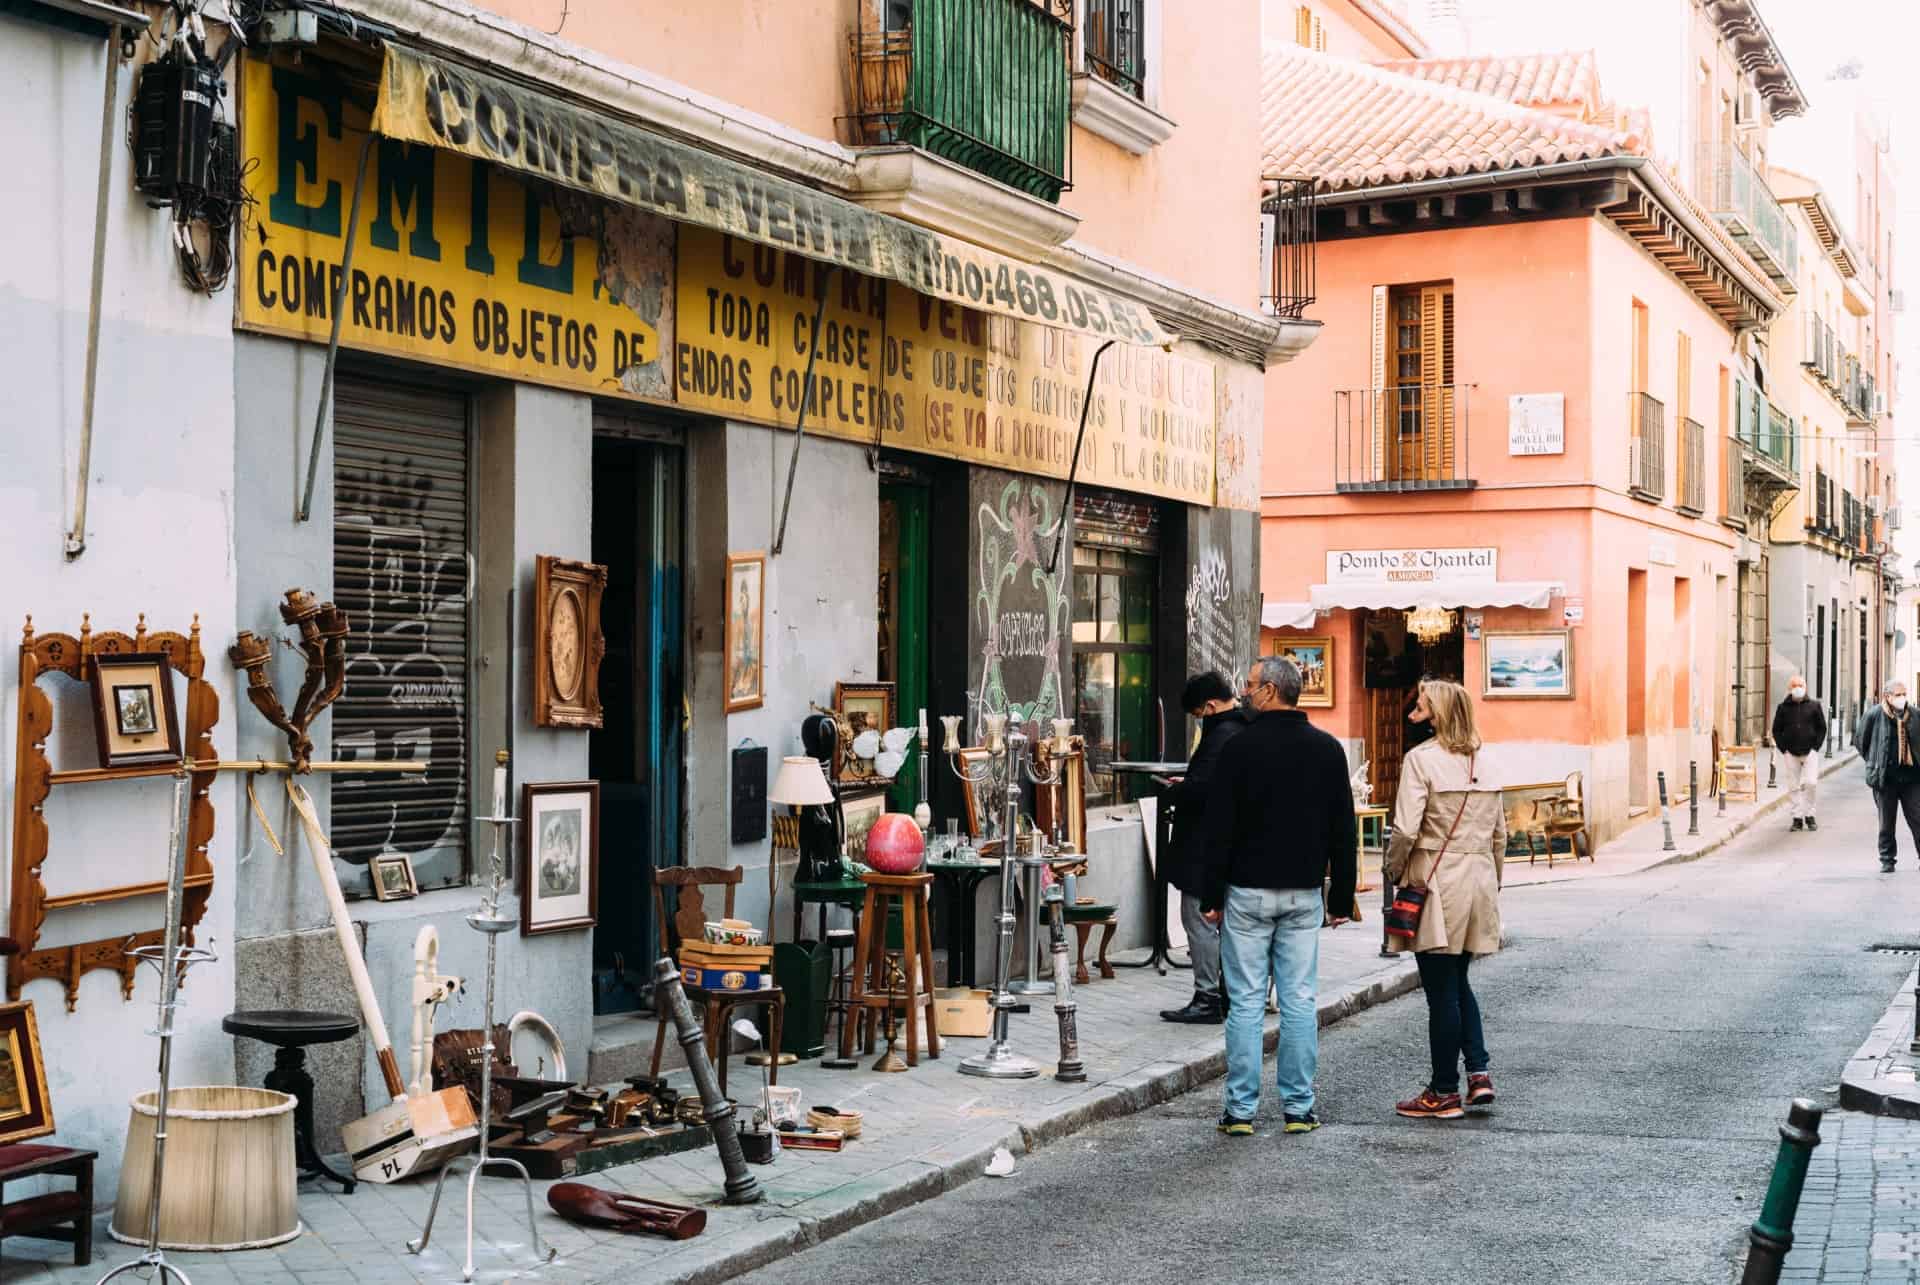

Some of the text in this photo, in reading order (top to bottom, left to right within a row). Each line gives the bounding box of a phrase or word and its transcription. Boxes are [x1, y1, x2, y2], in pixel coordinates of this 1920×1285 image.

[256, 248, 645, 378] COMPRAMOS OBJETOS DE
[706, 287, 769, 348] TODA
[793, 311, 870, 371] CLASE
[886, 335, 913, 381] DE
[932, 348, 1017, 407] OBJETOS
[770, 364, 905, 433] COMPLETAS
[963, 406, 987, 450] VA
[1338, 550, 1492, 573] Pombo Chantal
[381, 1157, 402, 1179] 14
